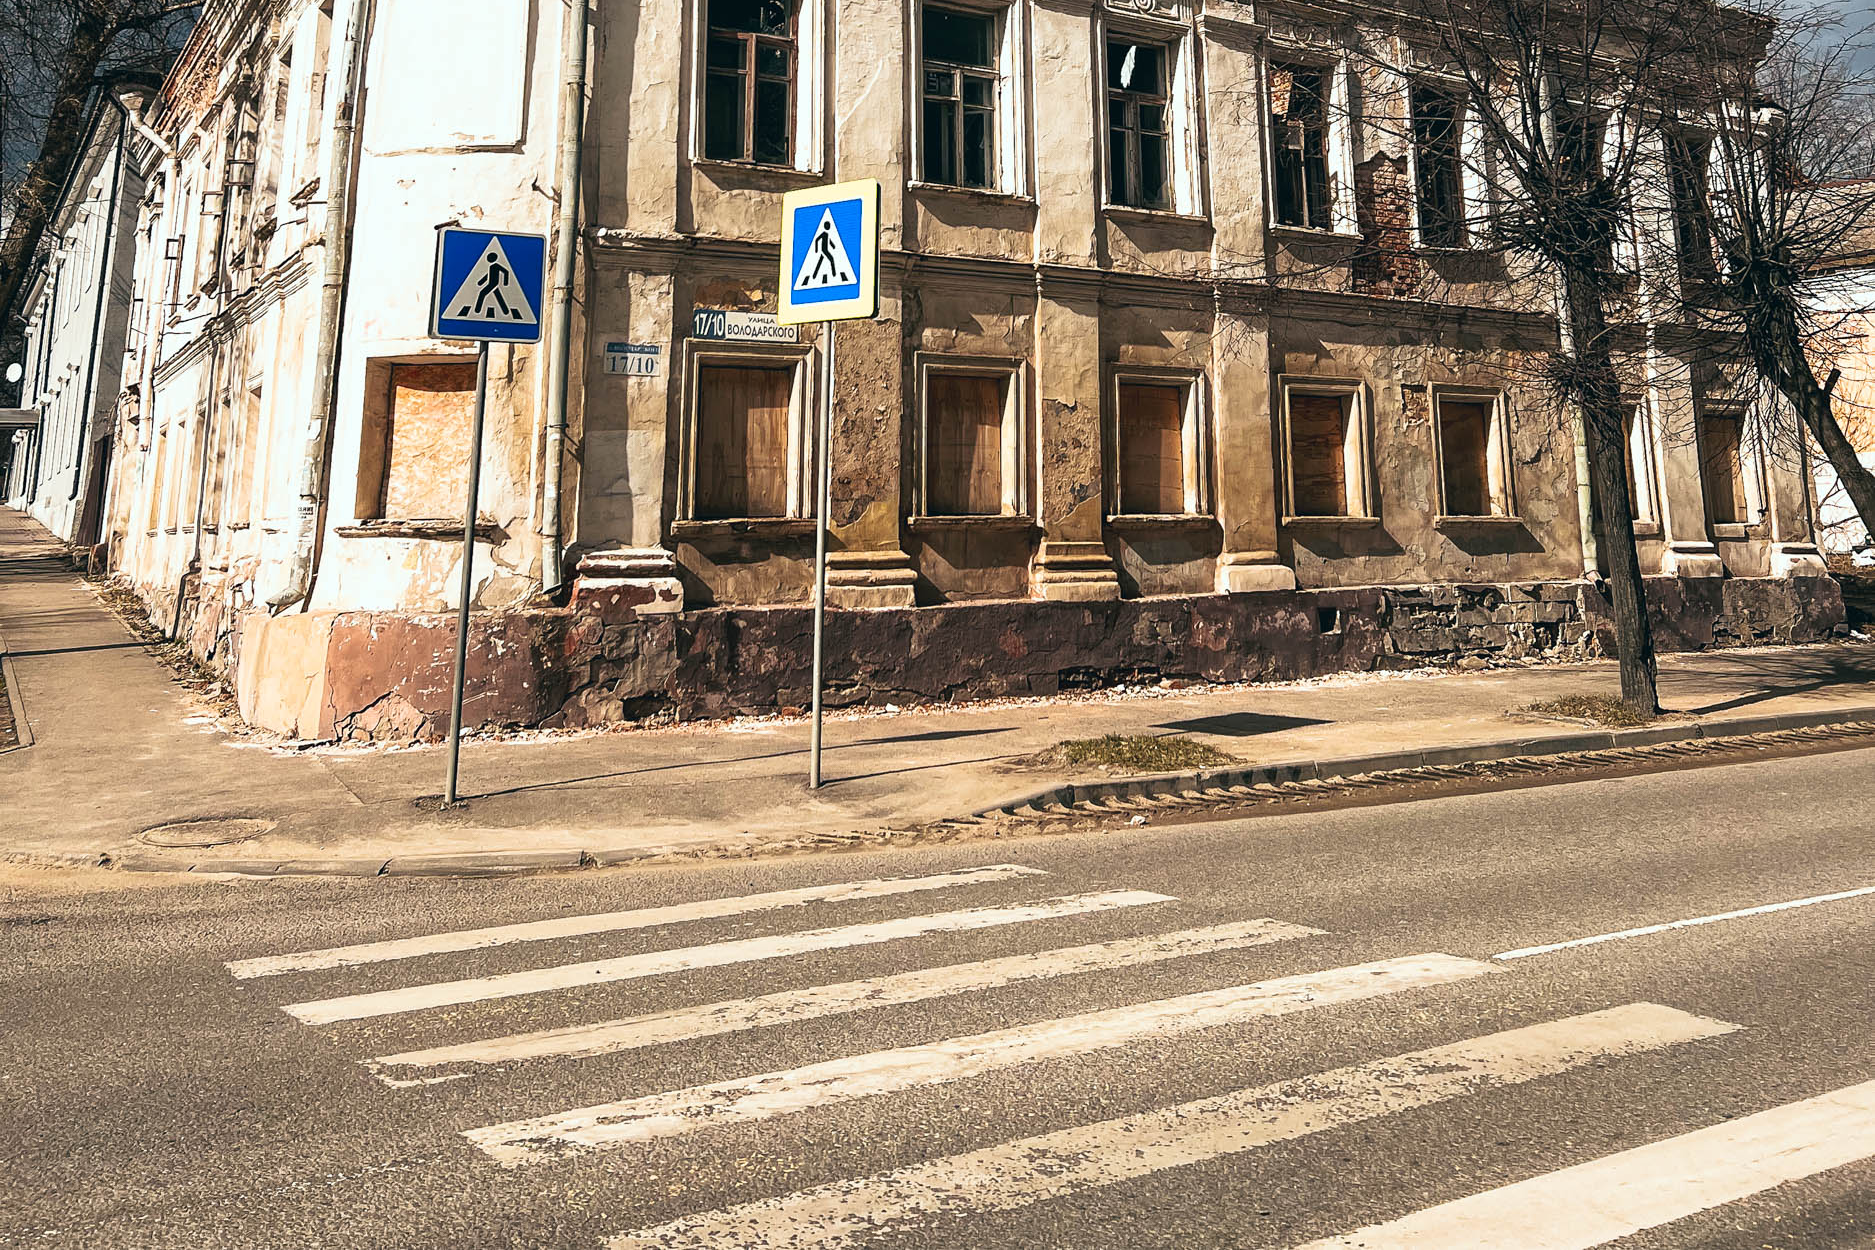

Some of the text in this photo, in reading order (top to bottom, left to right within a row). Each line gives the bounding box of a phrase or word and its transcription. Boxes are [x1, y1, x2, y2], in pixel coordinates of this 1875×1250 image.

[694, 313, 725, 337] 17/10
[747, 316, 776, 324] УЛИЦА
[727, 324, 795, 338] ВОЛОДАРСКОГО
[609, 355, 655, 374] 17/10
